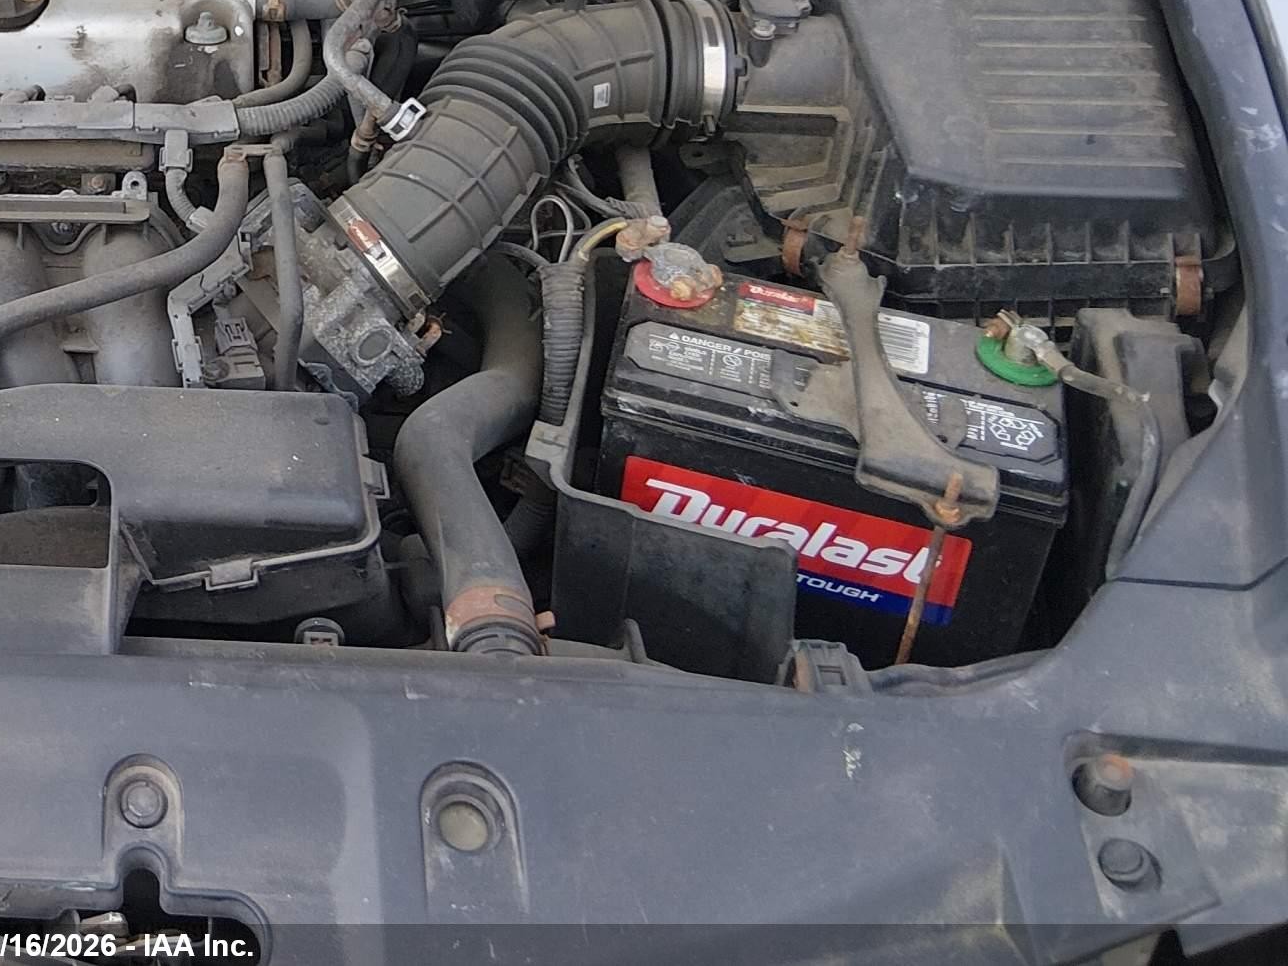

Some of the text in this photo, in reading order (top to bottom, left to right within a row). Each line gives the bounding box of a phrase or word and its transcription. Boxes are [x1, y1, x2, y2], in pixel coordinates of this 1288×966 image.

[681, 335, 732, 351] DANGER
[645, 478, 944, 584] Duralast
[794, 573, 880, 602] TOUGH
